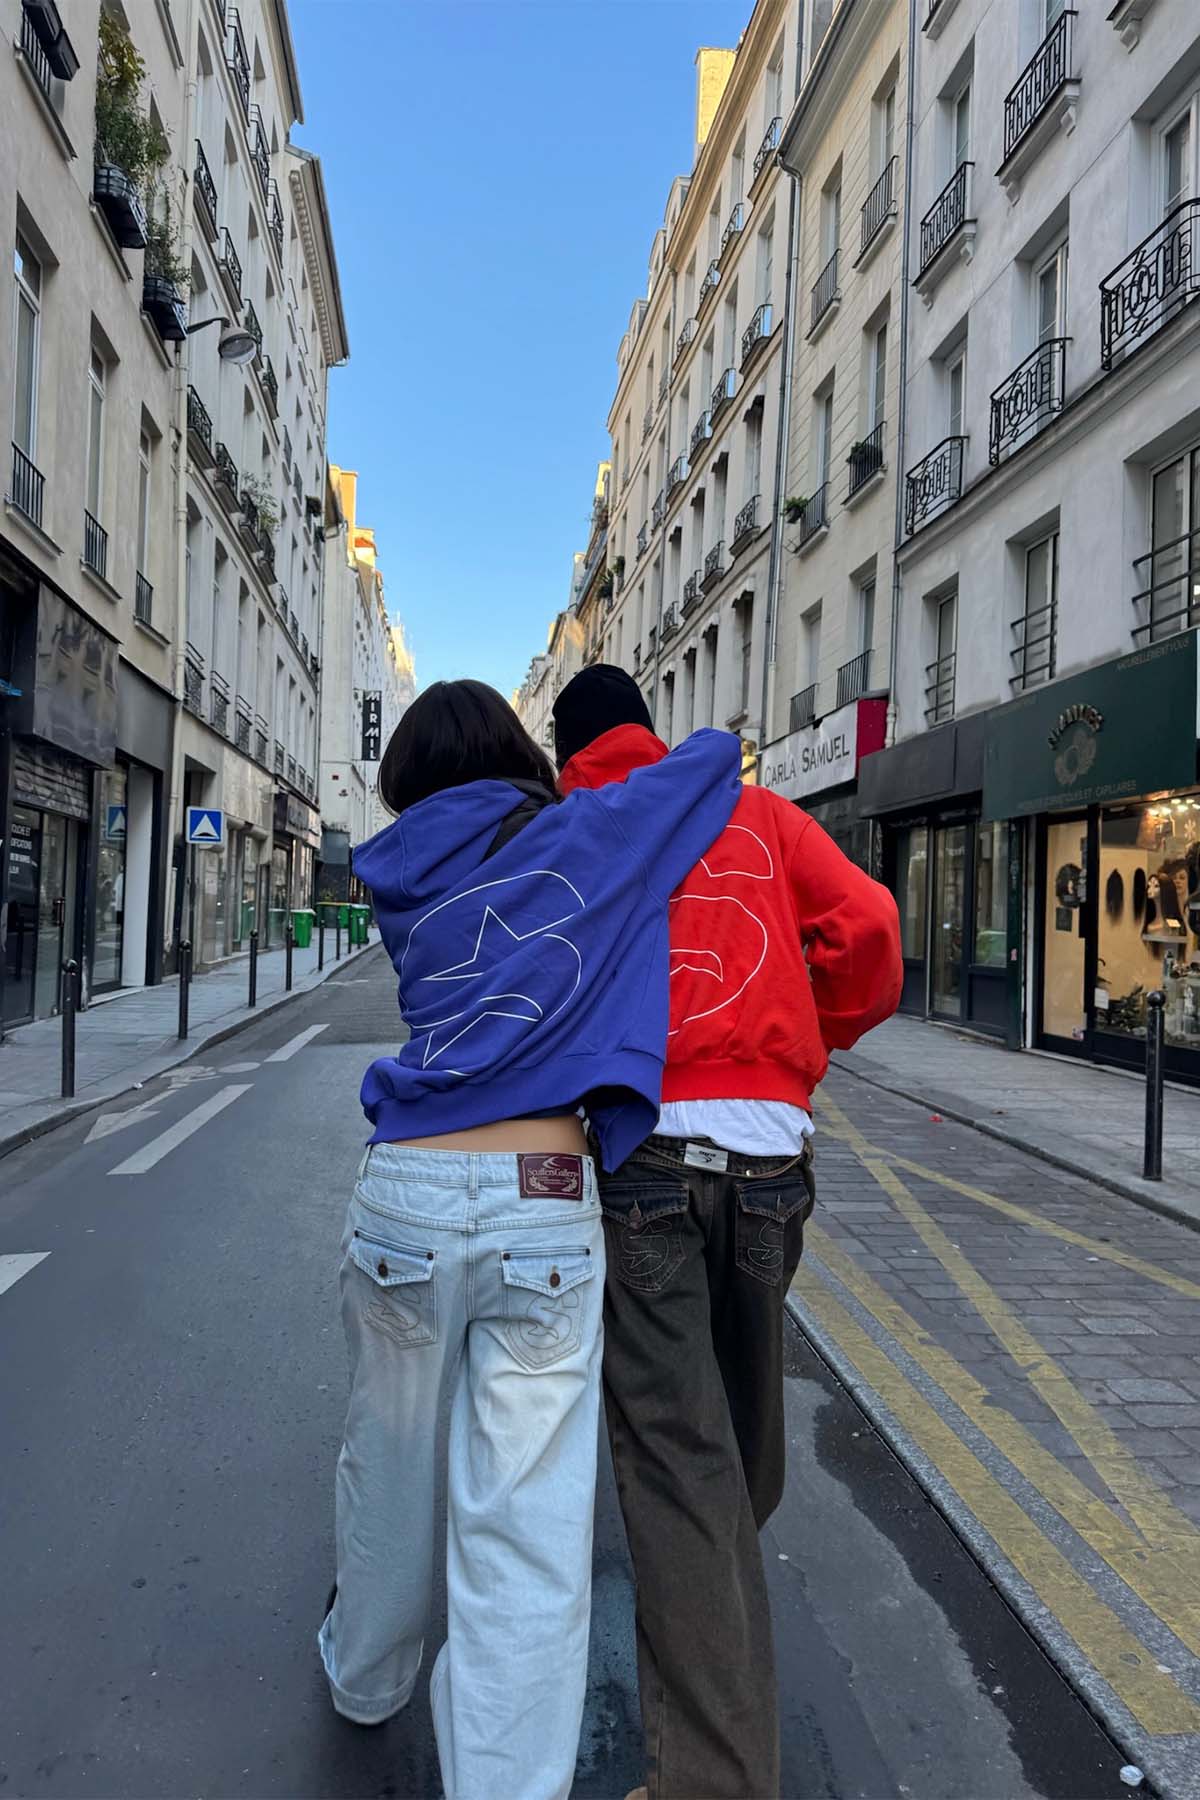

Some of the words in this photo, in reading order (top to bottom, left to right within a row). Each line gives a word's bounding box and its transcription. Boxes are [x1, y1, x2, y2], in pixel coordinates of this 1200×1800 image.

[365, 691, 380, 760] MIRMIL
[764, 759, 797, 788] CARLA
[802, 734, 850, 773] SAMUEL
